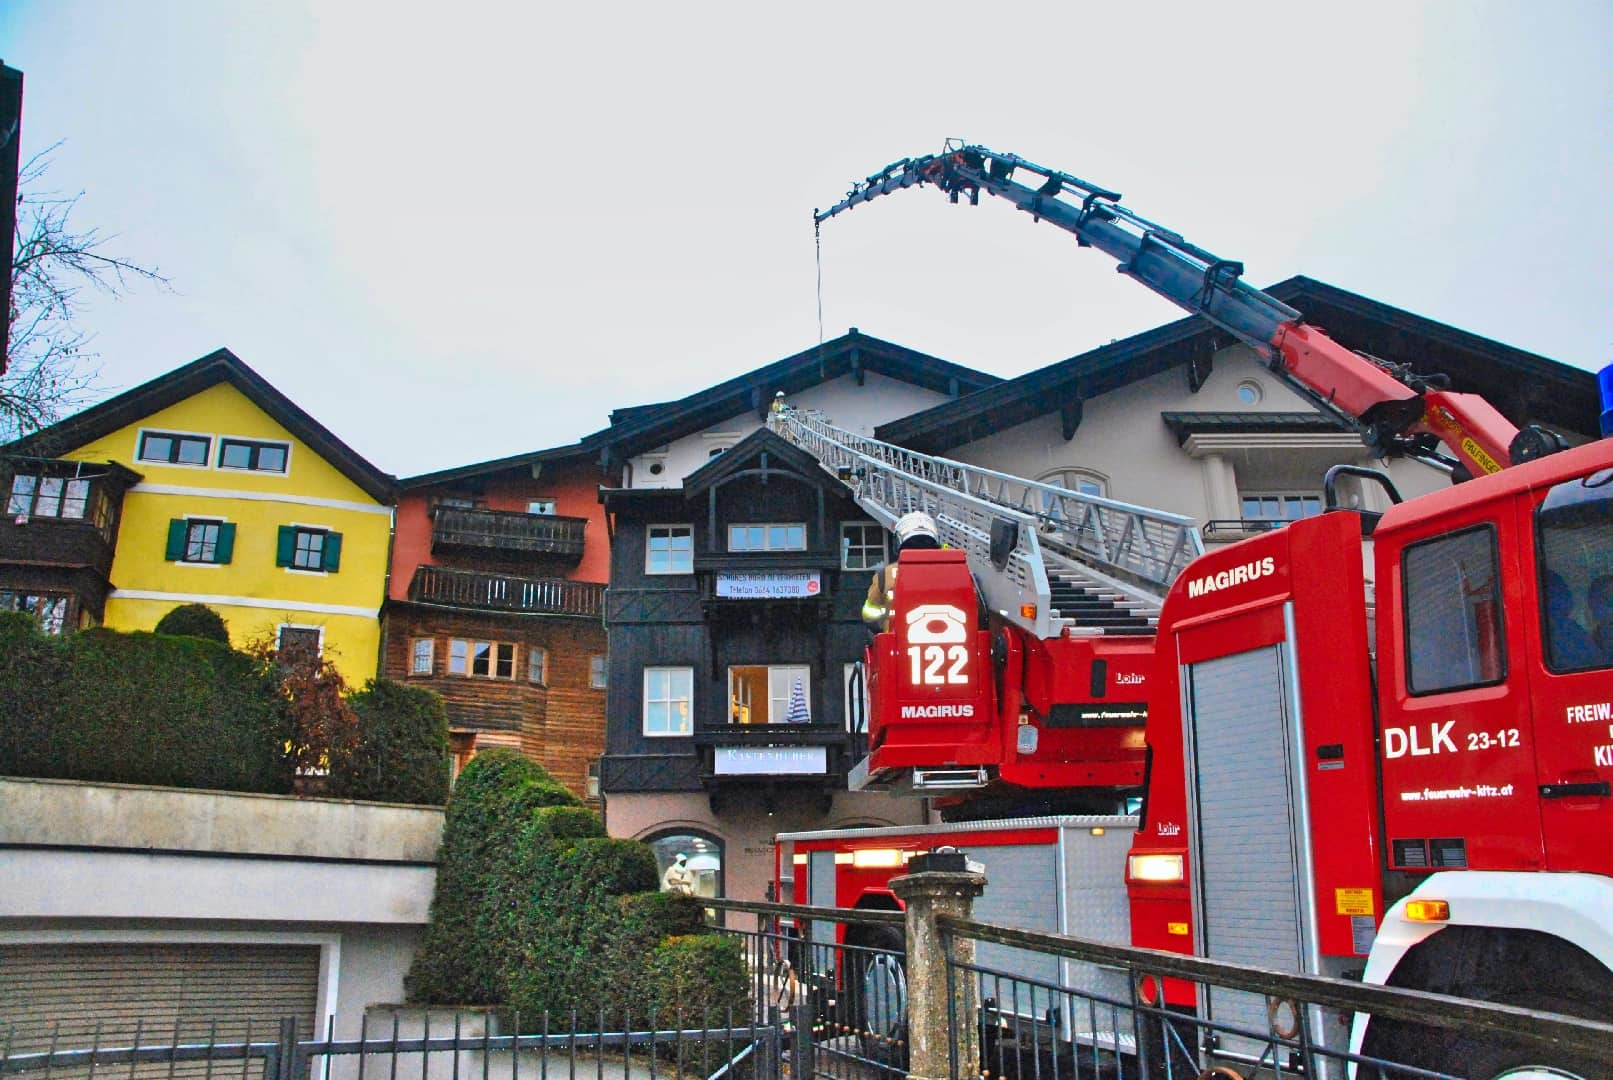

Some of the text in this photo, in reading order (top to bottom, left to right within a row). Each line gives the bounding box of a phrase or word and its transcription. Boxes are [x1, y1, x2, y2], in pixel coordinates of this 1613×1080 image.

[1188, 557, 1274, 598] MAGIRUS
[730, 585, 753, 594] Telefon
[907, 645, 969, 685] 122
[901, 705, 974, 718] MAGIRUS
[1385, 720, 1520, 759] DLK 23-12
[1594, 744, 1613, 767] KI
[1401, 784, 1514, 801] www.feuerwehr-kitz.at
